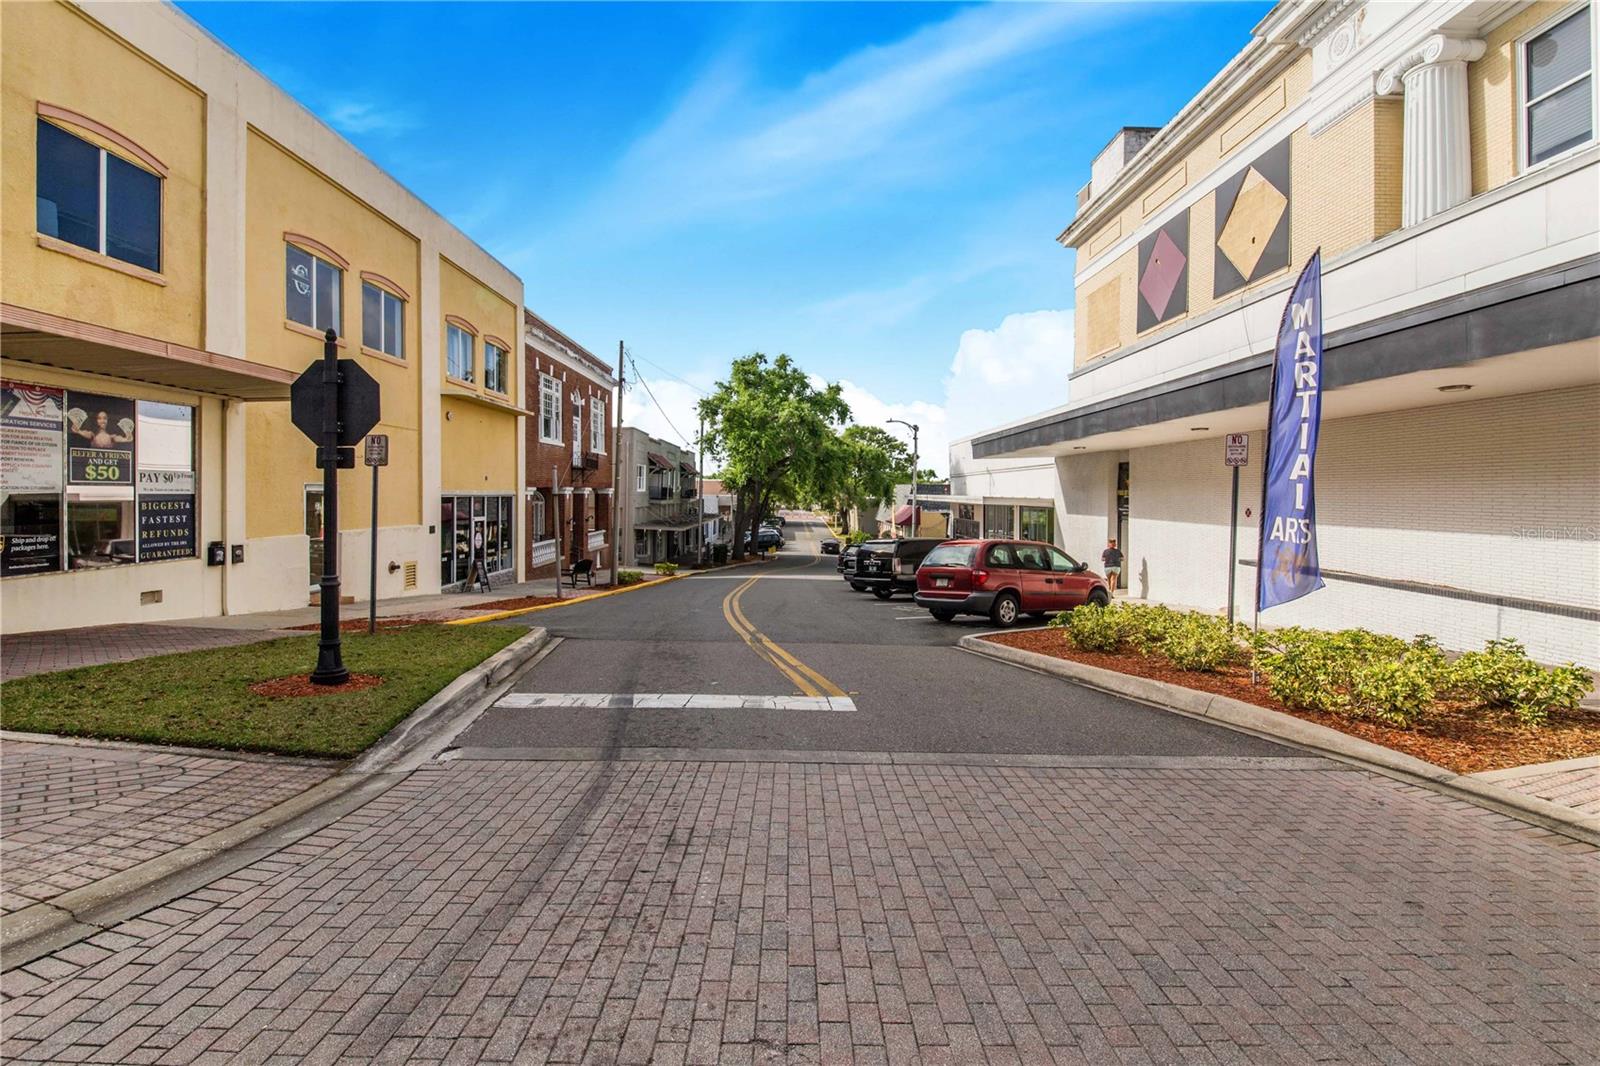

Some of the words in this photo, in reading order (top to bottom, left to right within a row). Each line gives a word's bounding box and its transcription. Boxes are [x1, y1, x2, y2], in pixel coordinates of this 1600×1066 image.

[1289, 298, 1317, 510] MARTIAL
[371, 436, 381, 445] NO
[1231, 434, 1243, 444] NO
[72, 450, 97, 458] REFER
[104, 452, 130, 460] FRIEND
[85, 464, 120, 480] $50
[139, 472, 160, 483] PAY
[163, 472, 174, 484] $0
[141, 514, 188, 524] FASTEST
[142, 528, 189, 539] REFUNDS
[10, 544, 36, 553] packages
